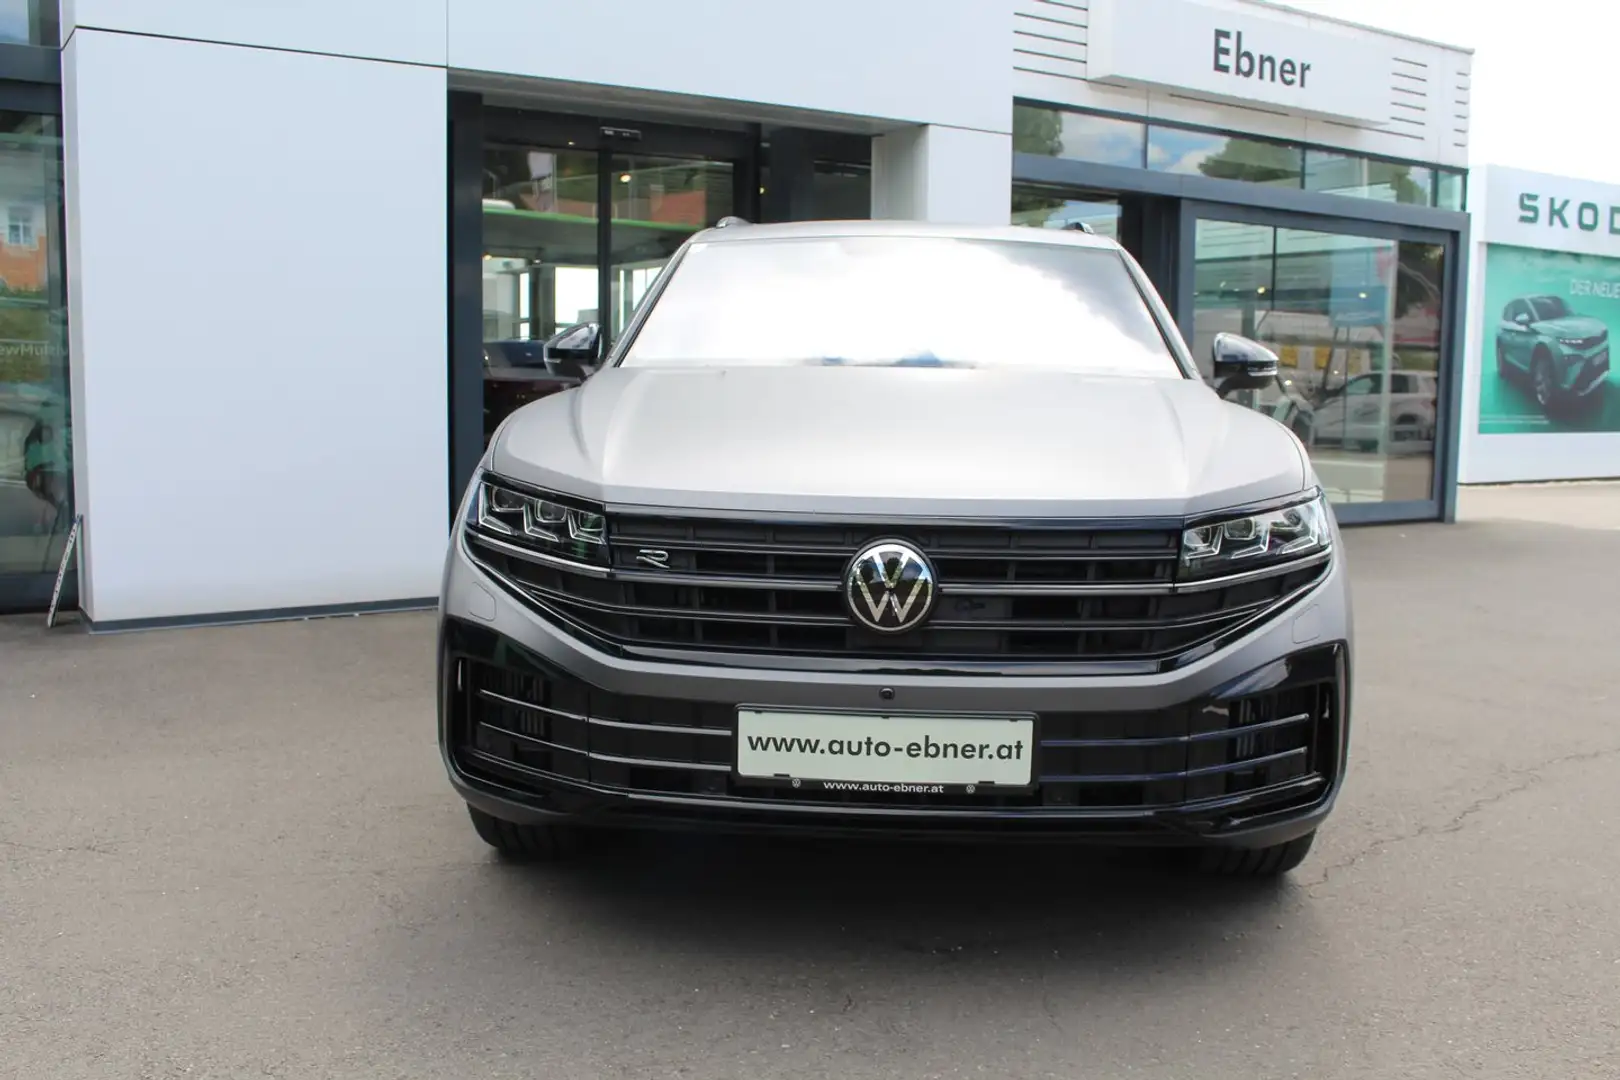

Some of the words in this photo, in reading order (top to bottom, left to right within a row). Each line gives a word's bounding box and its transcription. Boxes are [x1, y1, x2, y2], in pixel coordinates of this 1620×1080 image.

[1213, 28, 1311, 88] Ebner
[747, 734, 1025, 761] www.auto-ebner.at
[823, 781, 944, 794] www.auto-ebner.at
